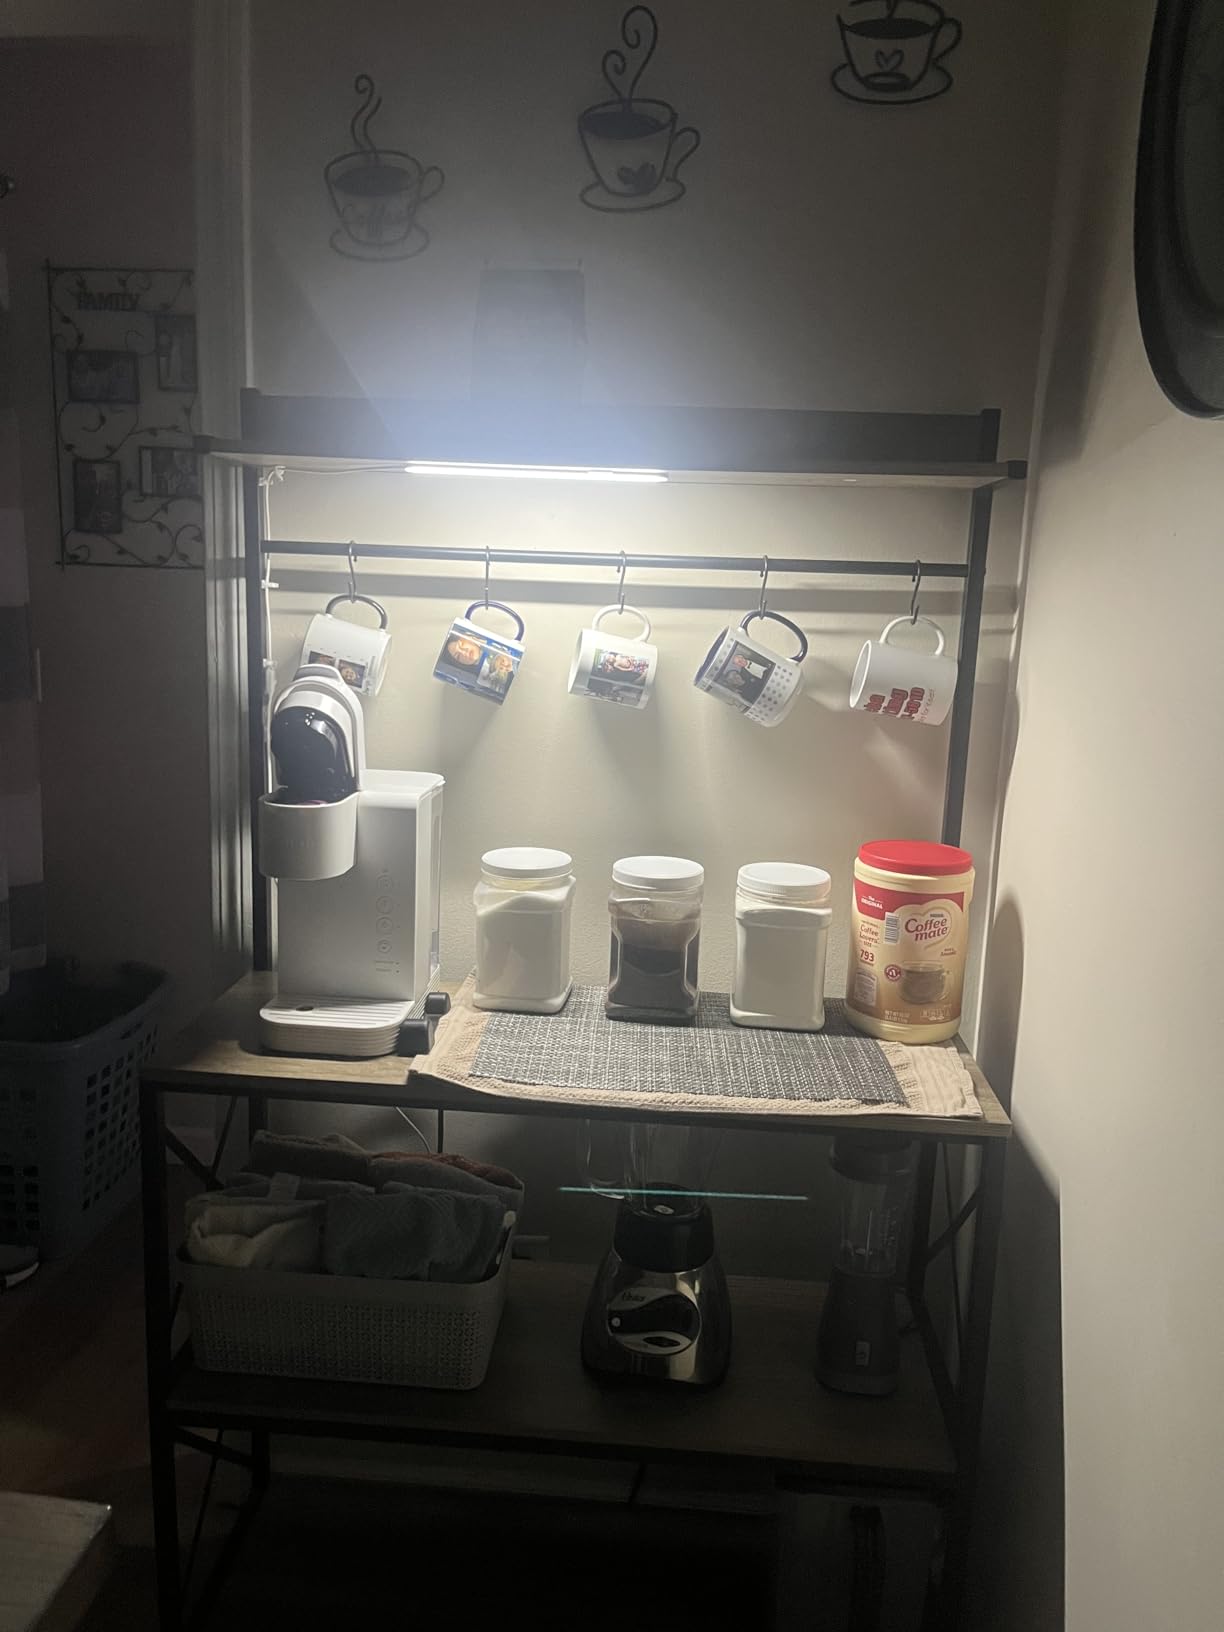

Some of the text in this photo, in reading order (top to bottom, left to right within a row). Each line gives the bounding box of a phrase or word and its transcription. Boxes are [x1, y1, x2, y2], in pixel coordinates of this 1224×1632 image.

[860, 924, 879, 937] Coffee
[905, 918, 947, 933] Coffee
[915, 926, 948, 941] mate
[860, 949, 875, 962] 793
